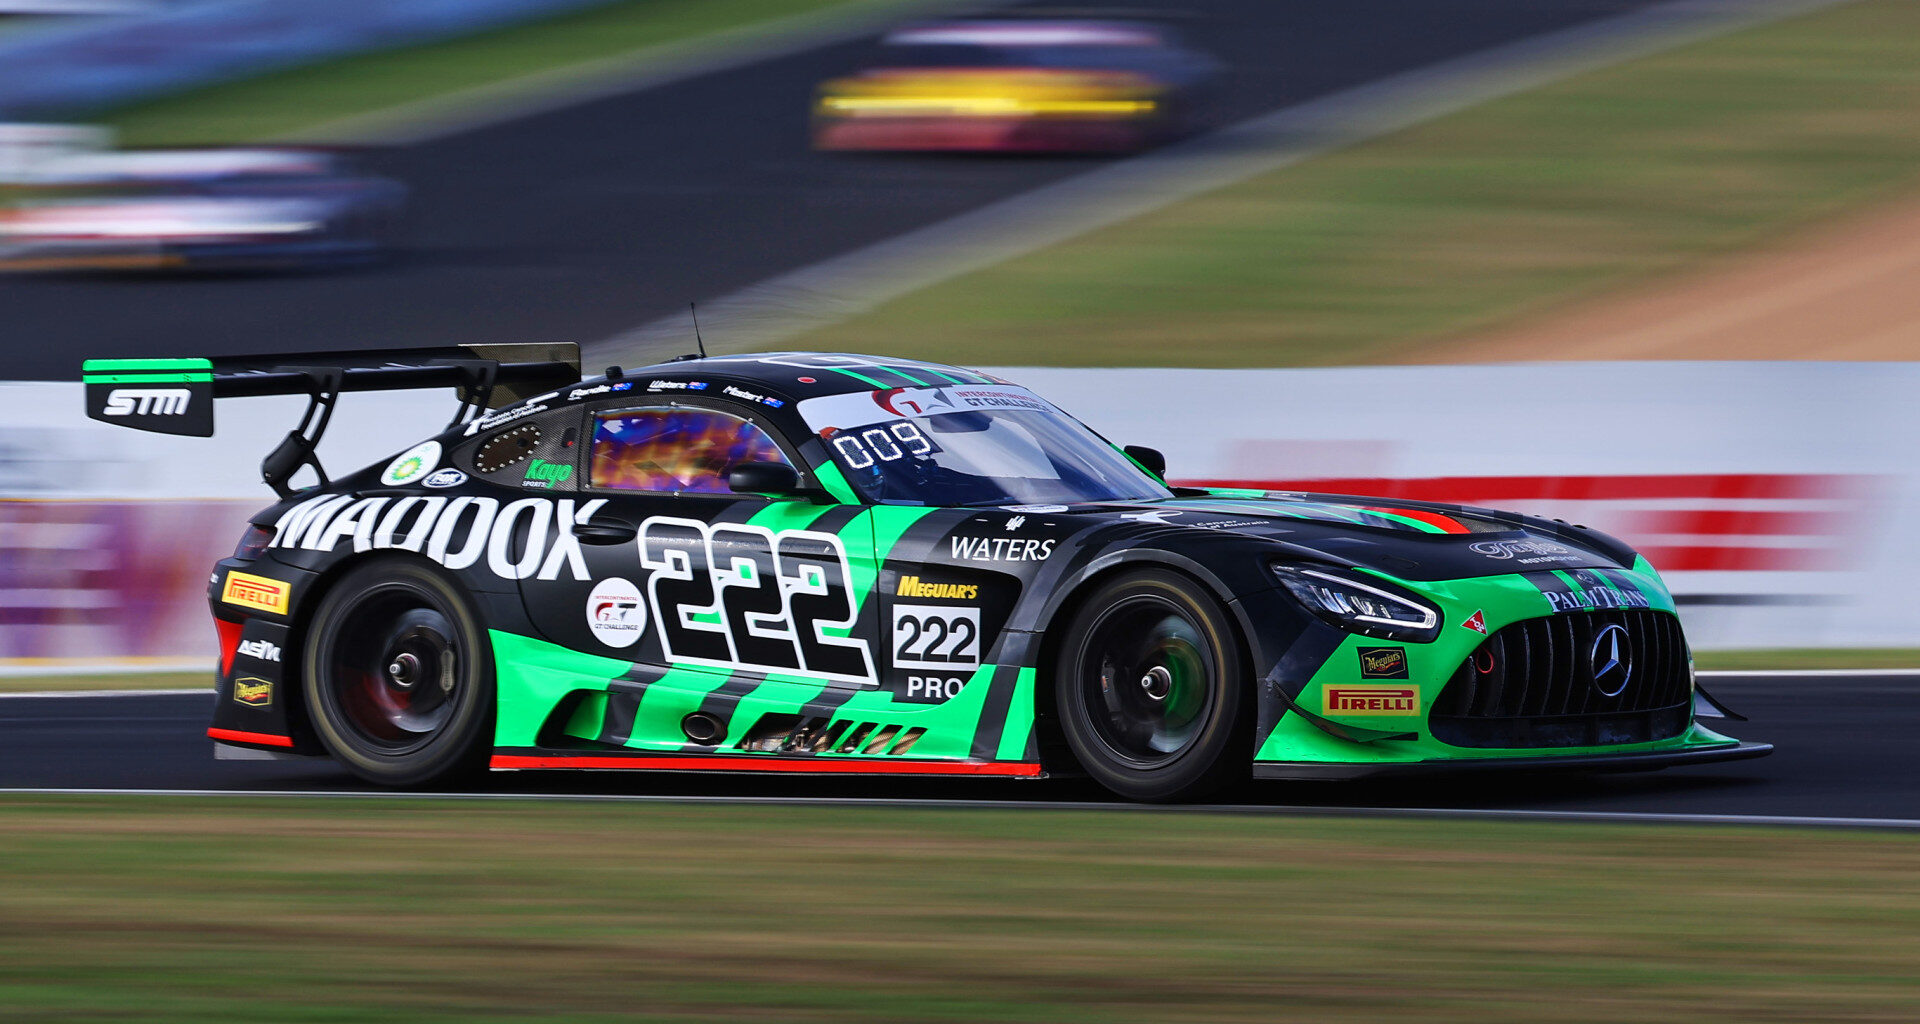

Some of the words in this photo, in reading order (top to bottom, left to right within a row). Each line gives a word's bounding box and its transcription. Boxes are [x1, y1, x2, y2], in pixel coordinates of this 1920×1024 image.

[649, 380, 688, 389] Waters
[723, 386, 764, 402] Mostert
[103, 388, 192, 415] STM
[964, 397, 984, 407] GT
[983, 398, 1054, 413] CHALLENGE
[833, 422, 931, 469] 009
[525, 459, 573, 488] Kayo
[268, 494, 609, 581] MADDOX
[951, 536, 1056, 561] WATERS
[228, 578, 281, 607] PIRELLI
[637, 515, 879, 686] 222
[896, 614, 976, 663] 222
[907, 676, 964, 699] PRO
[1329, 690, 1415, 710] PIRELLI
